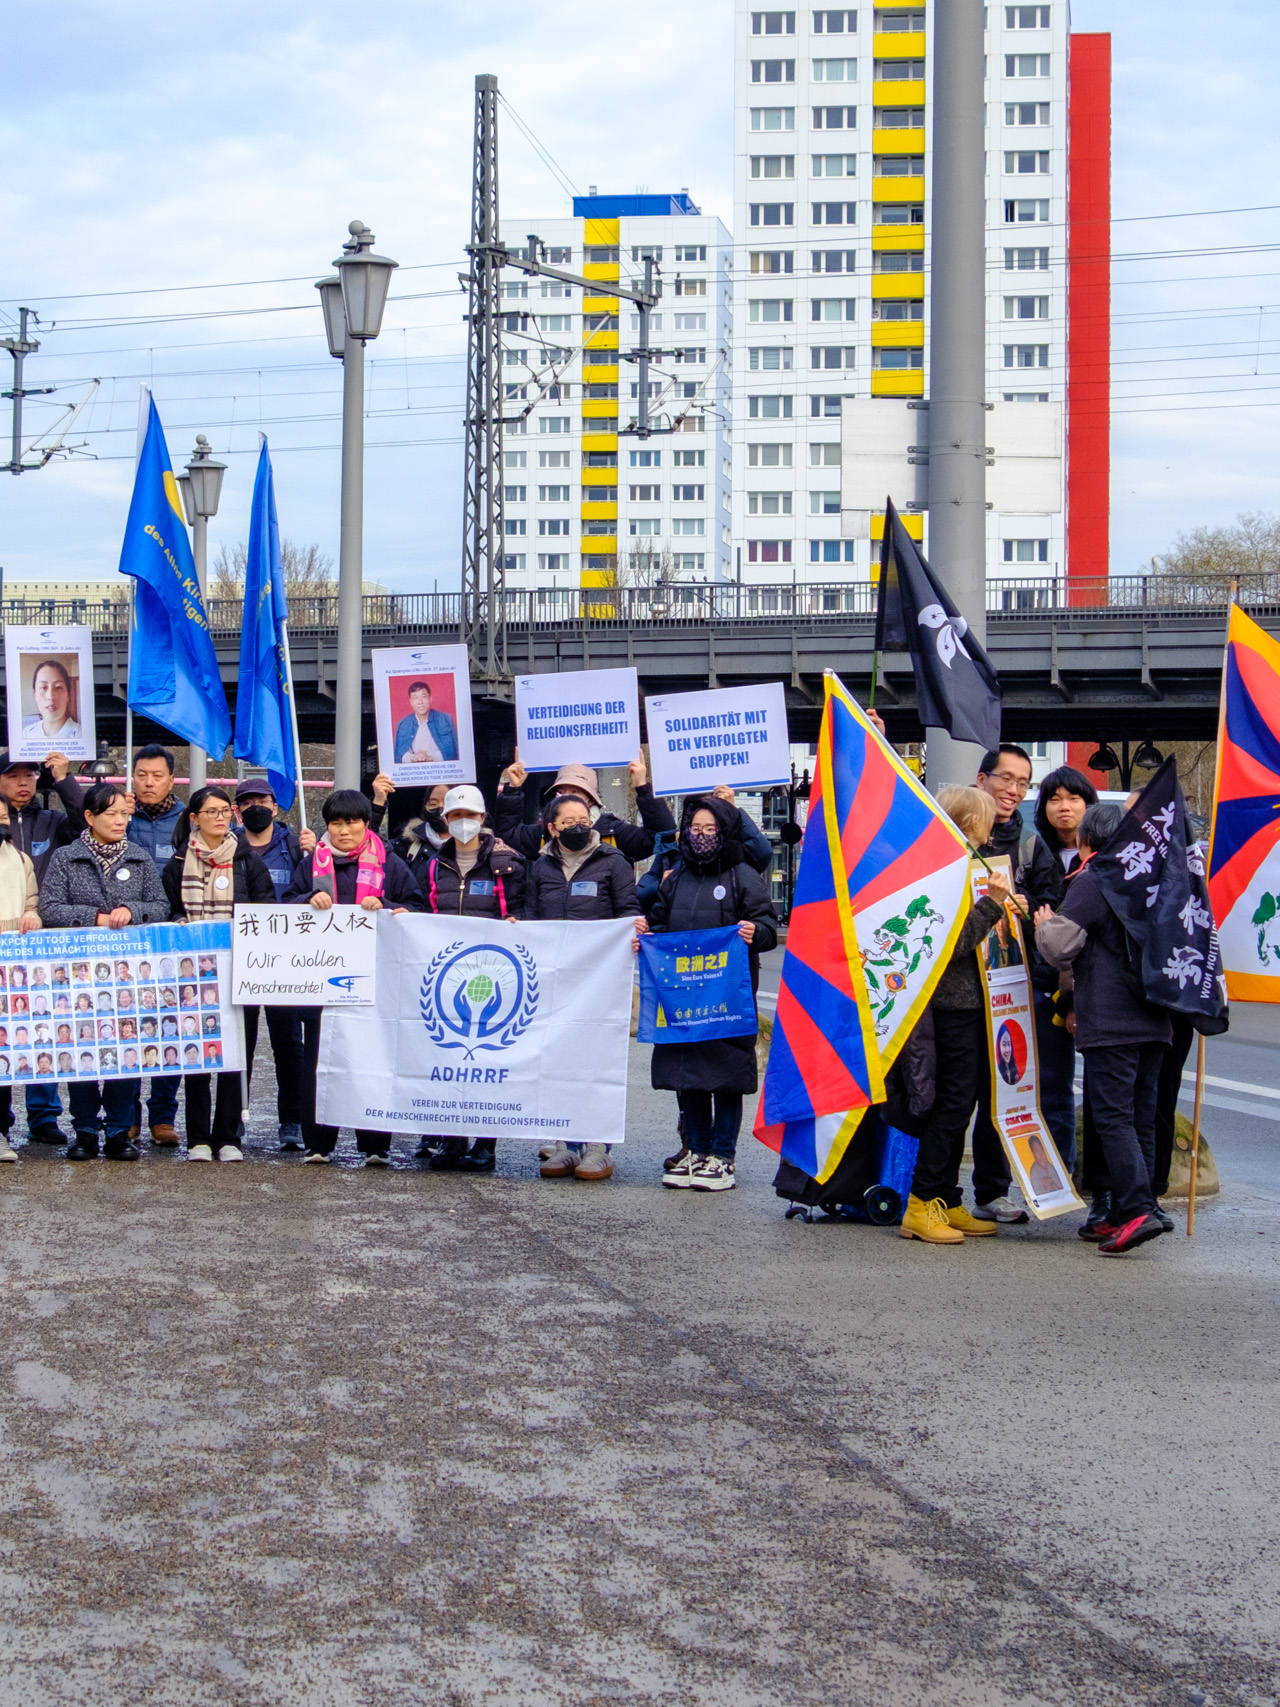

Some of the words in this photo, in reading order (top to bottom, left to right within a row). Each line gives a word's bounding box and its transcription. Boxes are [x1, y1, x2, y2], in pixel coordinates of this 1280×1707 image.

[144, 525, 164, 546] des
[528, 702, 602, 720] VERTEIDIGUNG
[605, 701, 625, 714] DER
[527, 721, 628, 740] RELIGIONSFREIHEIT!
[665, 711, 741, 732] SOLIDARITÄT
[744, 710, 767, 724] MIT
[668, 738, 691, 752] DEN
[694, 730, 768, 749] VERFOLGTEN
[690, 751, 749, 770] GRUPPEN!
[1141, 820, 1162, 846] FREE
[239, 912, 375, 936] 我们要人权
[1, 936, 28, 946] KPCH
[30, 937, 43, 945] ZU
[45, 935, 70, 944] TODE
[73, 932, 129, 943] VERFOLGTE
[15, 948, 33, 956] DES
[36, 944, 110, 955] ALLMÄCHTIGEN
[112, 942, 150, 952] GOTTES
[247, 951, 282, 968] Wir
[291, 950, 346, 968] wollen
[238, 980, 324, 995] Menschenrechte!
[992, 993, 1014, 1008] CHINA,
[430, 1066, 510, 1084] ADHRRF
[412, 1099, 440, 1108] VEREIN
[441, 1100, 457, 1110] ZUR
[459, 1101, 522, 1112] VERTEIDIGUNG
[365, 1108, 384, 1118] DER
[386, 1111, 461, 1123] MENSCHENRECHTE
[462, 1115, 480, 1124] UND
[482, 1116, 570, 1128] RELIGIONSFREIHEIT
